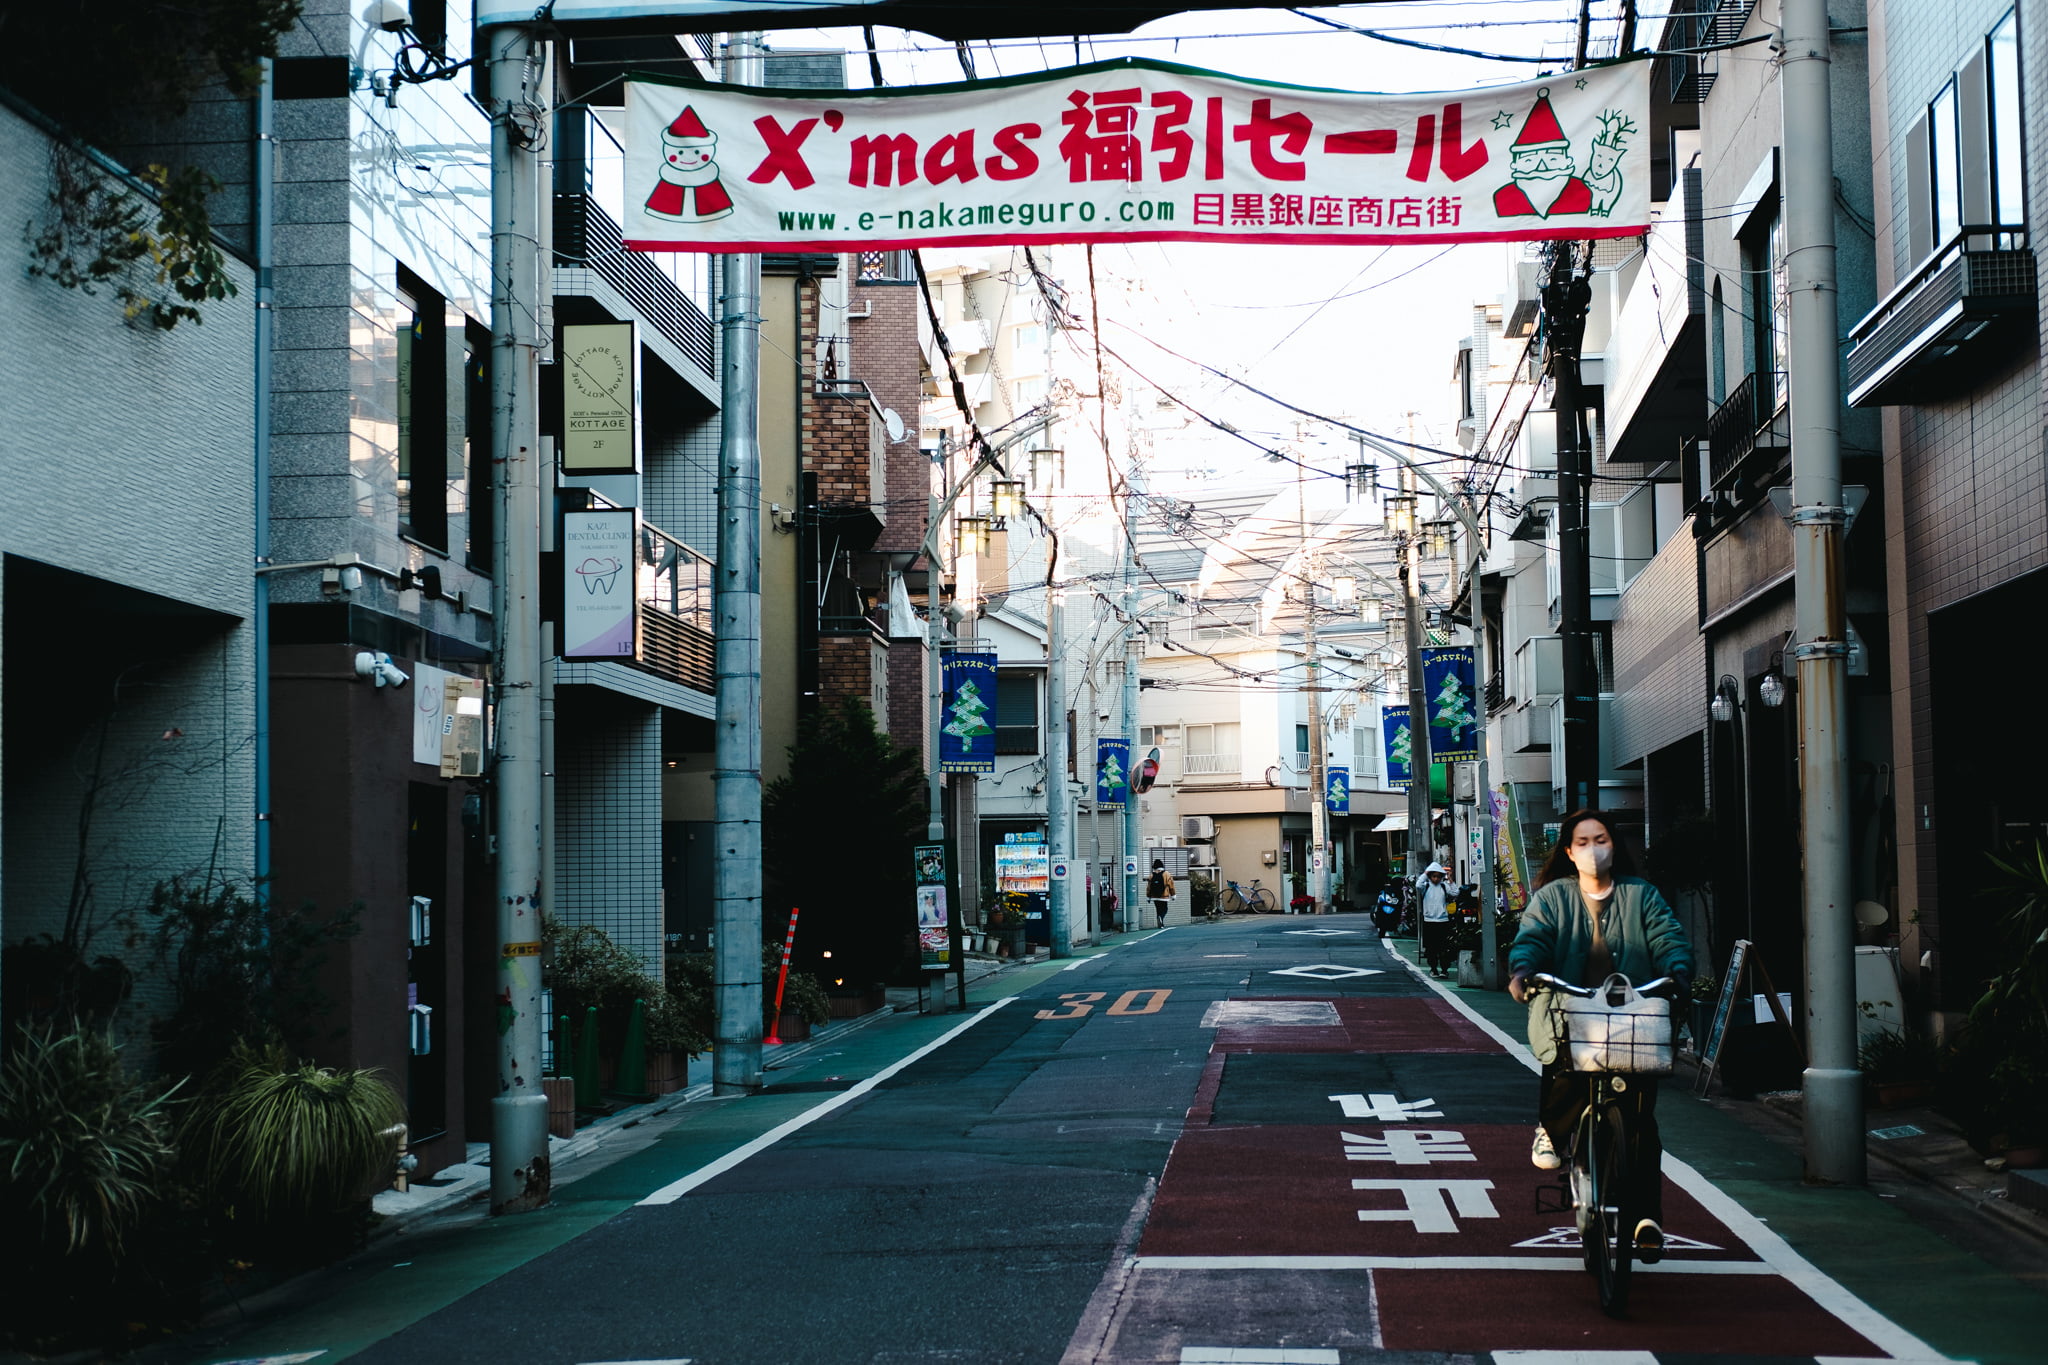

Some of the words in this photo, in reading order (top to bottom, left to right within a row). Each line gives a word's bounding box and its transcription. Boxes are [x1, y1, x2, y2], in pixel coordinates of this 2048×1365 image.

[777, 200, 1176, 231] www.e-nakameguro.com
[1192, 192, 1463, 228] 目黒銀座商店街
[570, 419, 625, 428] KOTTAGE
[593, 440, 605, 449] 2F
[568, 532, 600, 541] DENTAL
[601, 531, 631, 540] CLINIC
[618, 641, 633, 653] 1F
[943, 660, 996, 672] クリスマスセール
[1033, 989, 1174, 1020] 30
